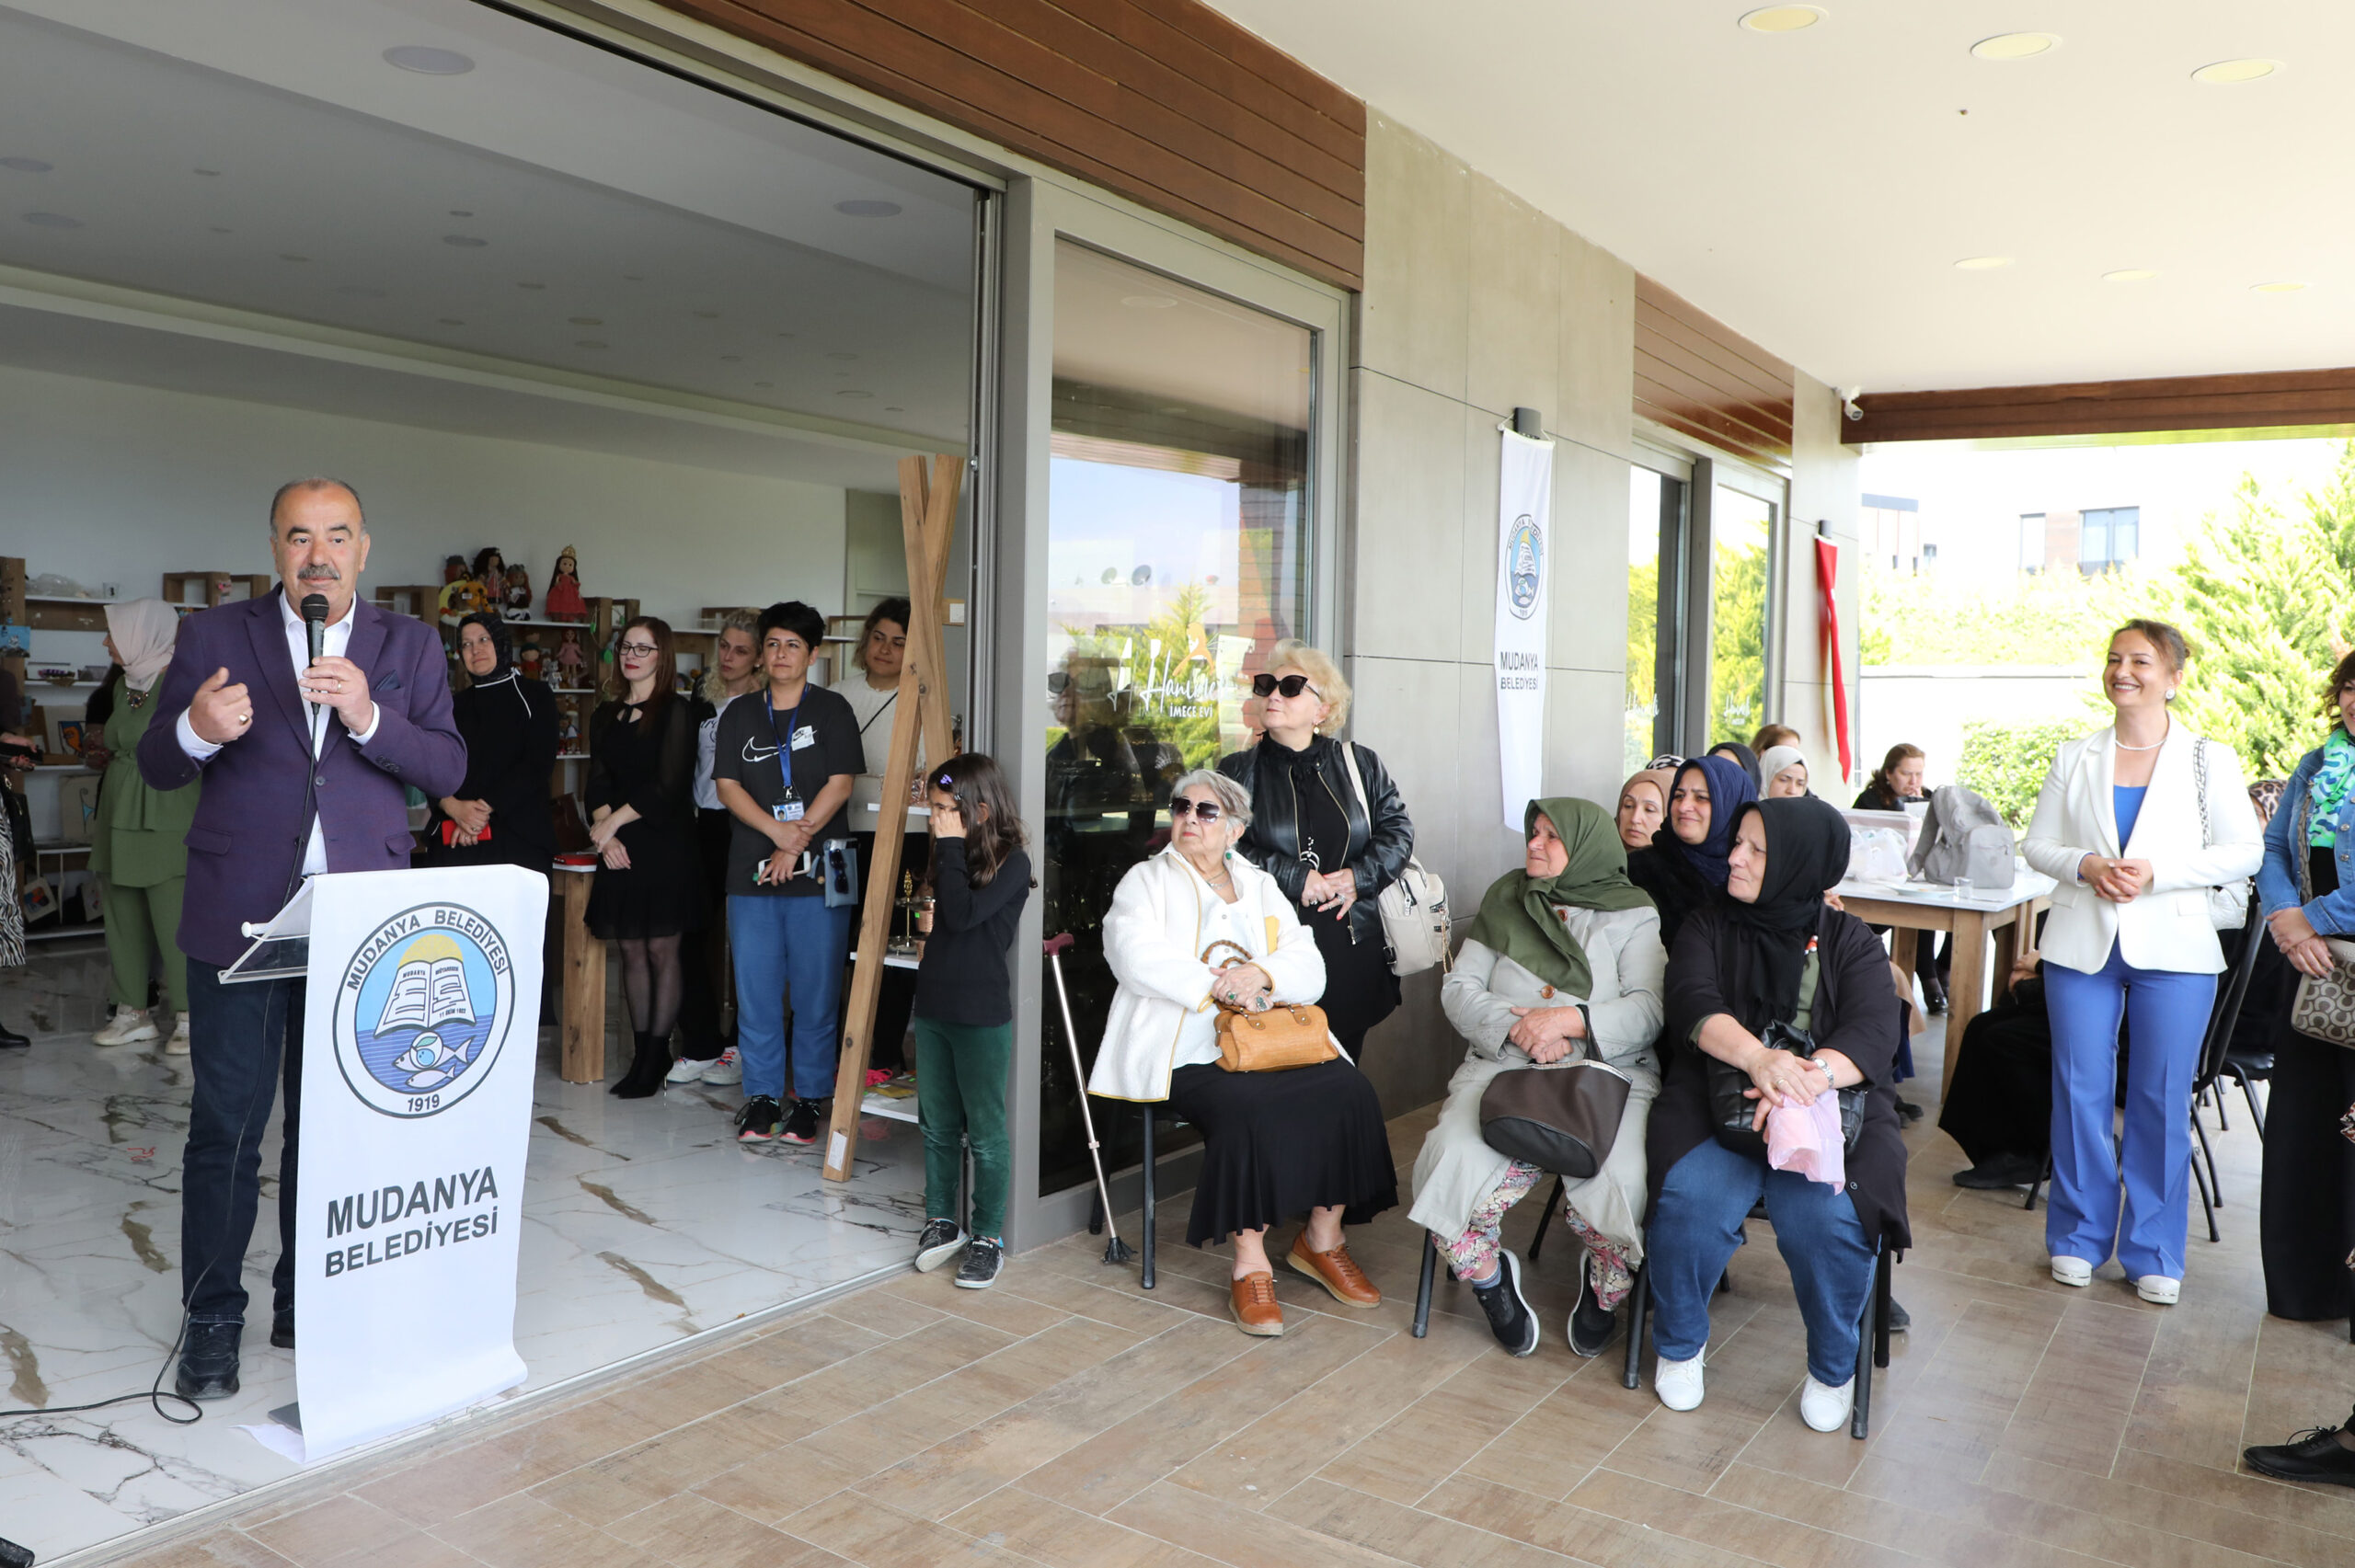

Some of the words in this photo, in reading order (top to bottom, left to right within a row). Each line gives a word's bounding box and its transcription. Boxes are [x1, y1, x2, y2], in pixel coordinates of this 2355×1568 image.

[1500, 651, 1538, 671] MUDANYA
[1500, 676, 1539, 690] BELEDYESİ
[1169, 702, 1197, 717] İMECE
[1199, 704, 1213, 717] EVİ
[347, 914, 420, 990] MUDANYA
[434, 910, 510, 976] BELEDİYESİ
[403, 970, 425, 978] MUDANYA
[407, 1093, 440, 1112] 1919
[327, 1166, 498, 1239] MUDANYA
[326, 1206, 498, 1277] BELEDİYESİ
